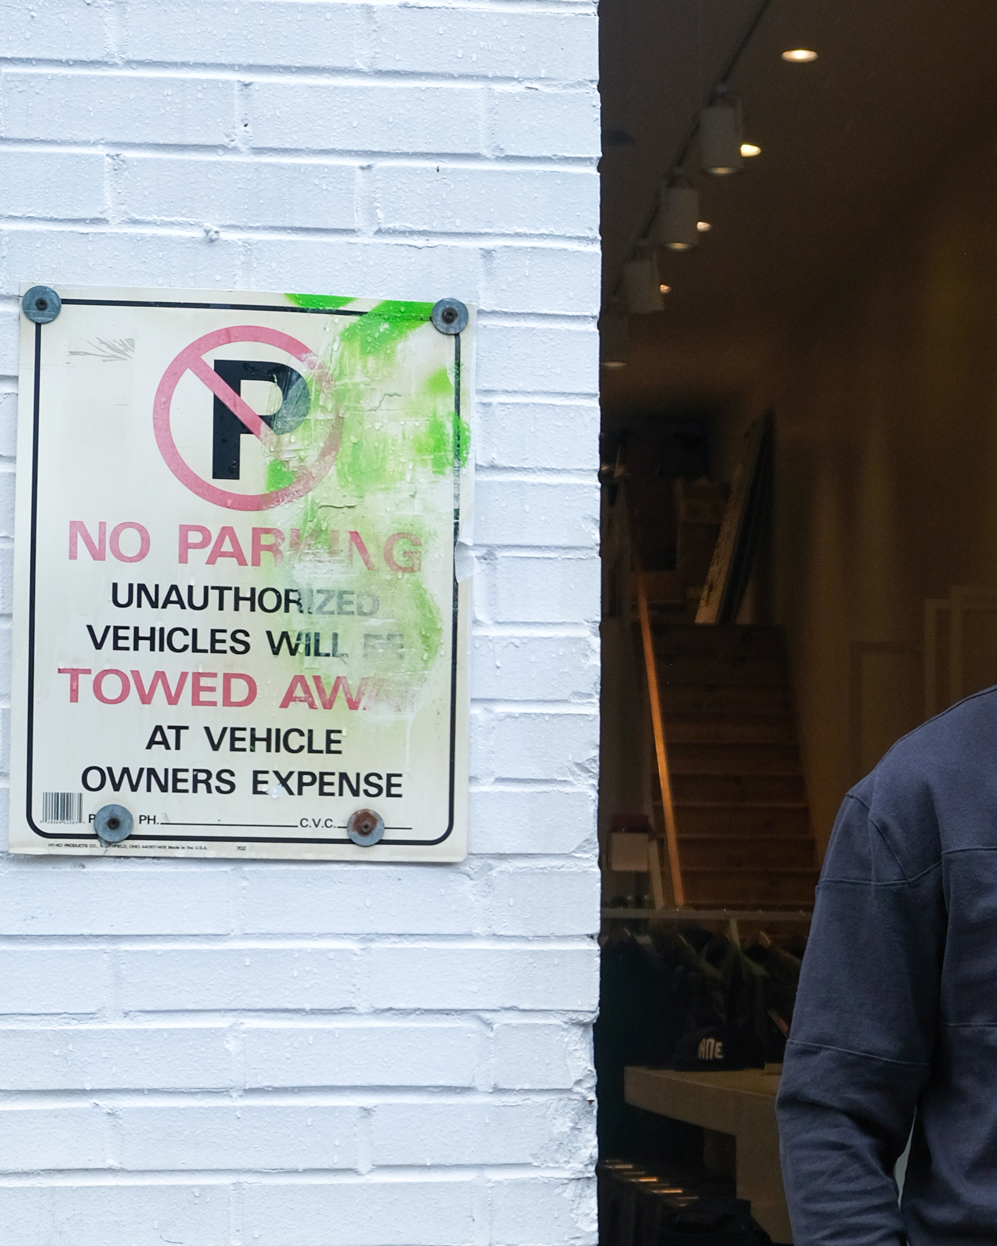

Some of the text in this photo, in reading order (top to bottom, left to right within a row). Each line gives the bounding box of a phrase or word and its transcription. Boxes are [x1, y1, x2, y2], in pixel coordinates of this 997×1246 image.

[69, 520, 151, 563] NO
[111, 582, 380, 616] UNAUTHORIZED
[86, 624, 251, 655] VEHICLES
[266, 630, 346, 658] WILL
[58, 667, 257, 707] TOWED
[145, 725, 343, 754] AT VEHICLE
[81, 765, 403, 798] OWNERS EXPENSE
[139, 815, 160, 824] PH.
[299, 818, 336, 828] C.V.C.
